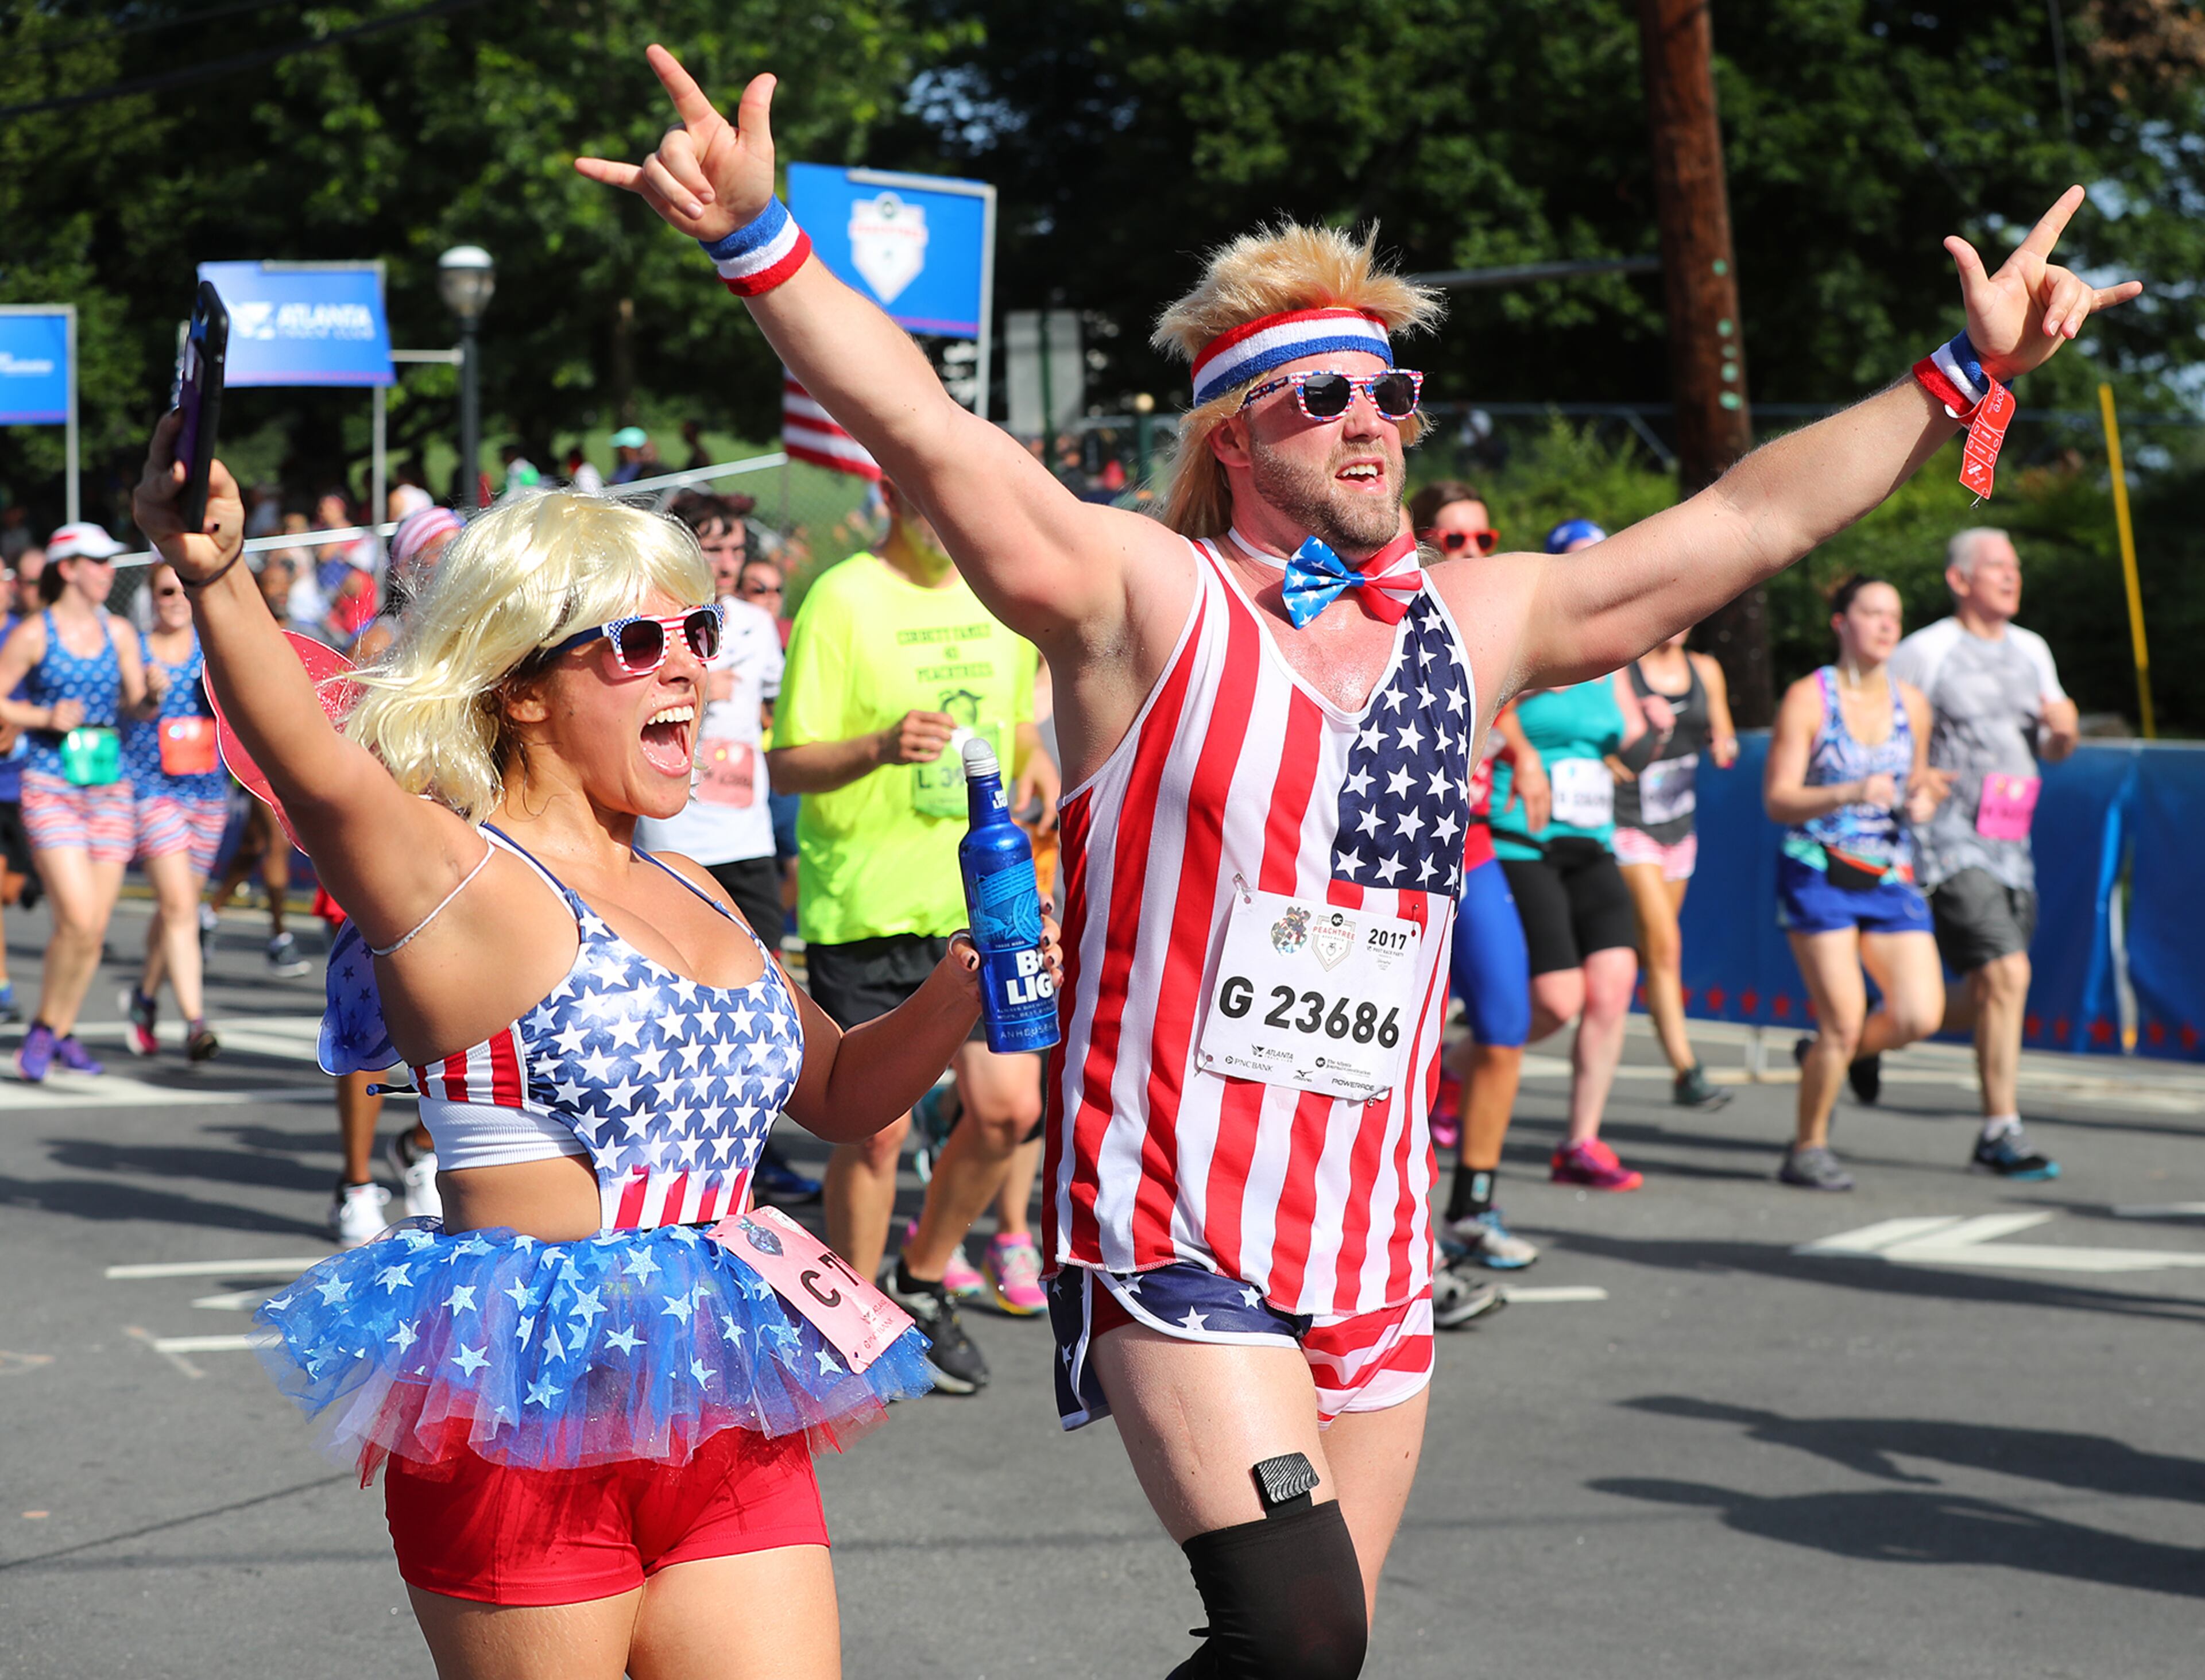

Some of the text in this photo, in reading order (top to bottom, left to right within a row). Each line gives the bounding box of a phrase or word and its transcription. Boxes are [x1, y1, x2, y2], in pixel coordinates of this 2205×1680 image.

[1313, 926, 1356, 940] PEACHTREE
[1368, 928, 1407, 950] 2017
[1219, 976, 1399, 1049] G 23686
[1265, 1048, 1293, 1060] ATLANTA
[1235, 1058, 1274, 1073] PNC BANK
[800, 1252, 860, 1308] C 7
